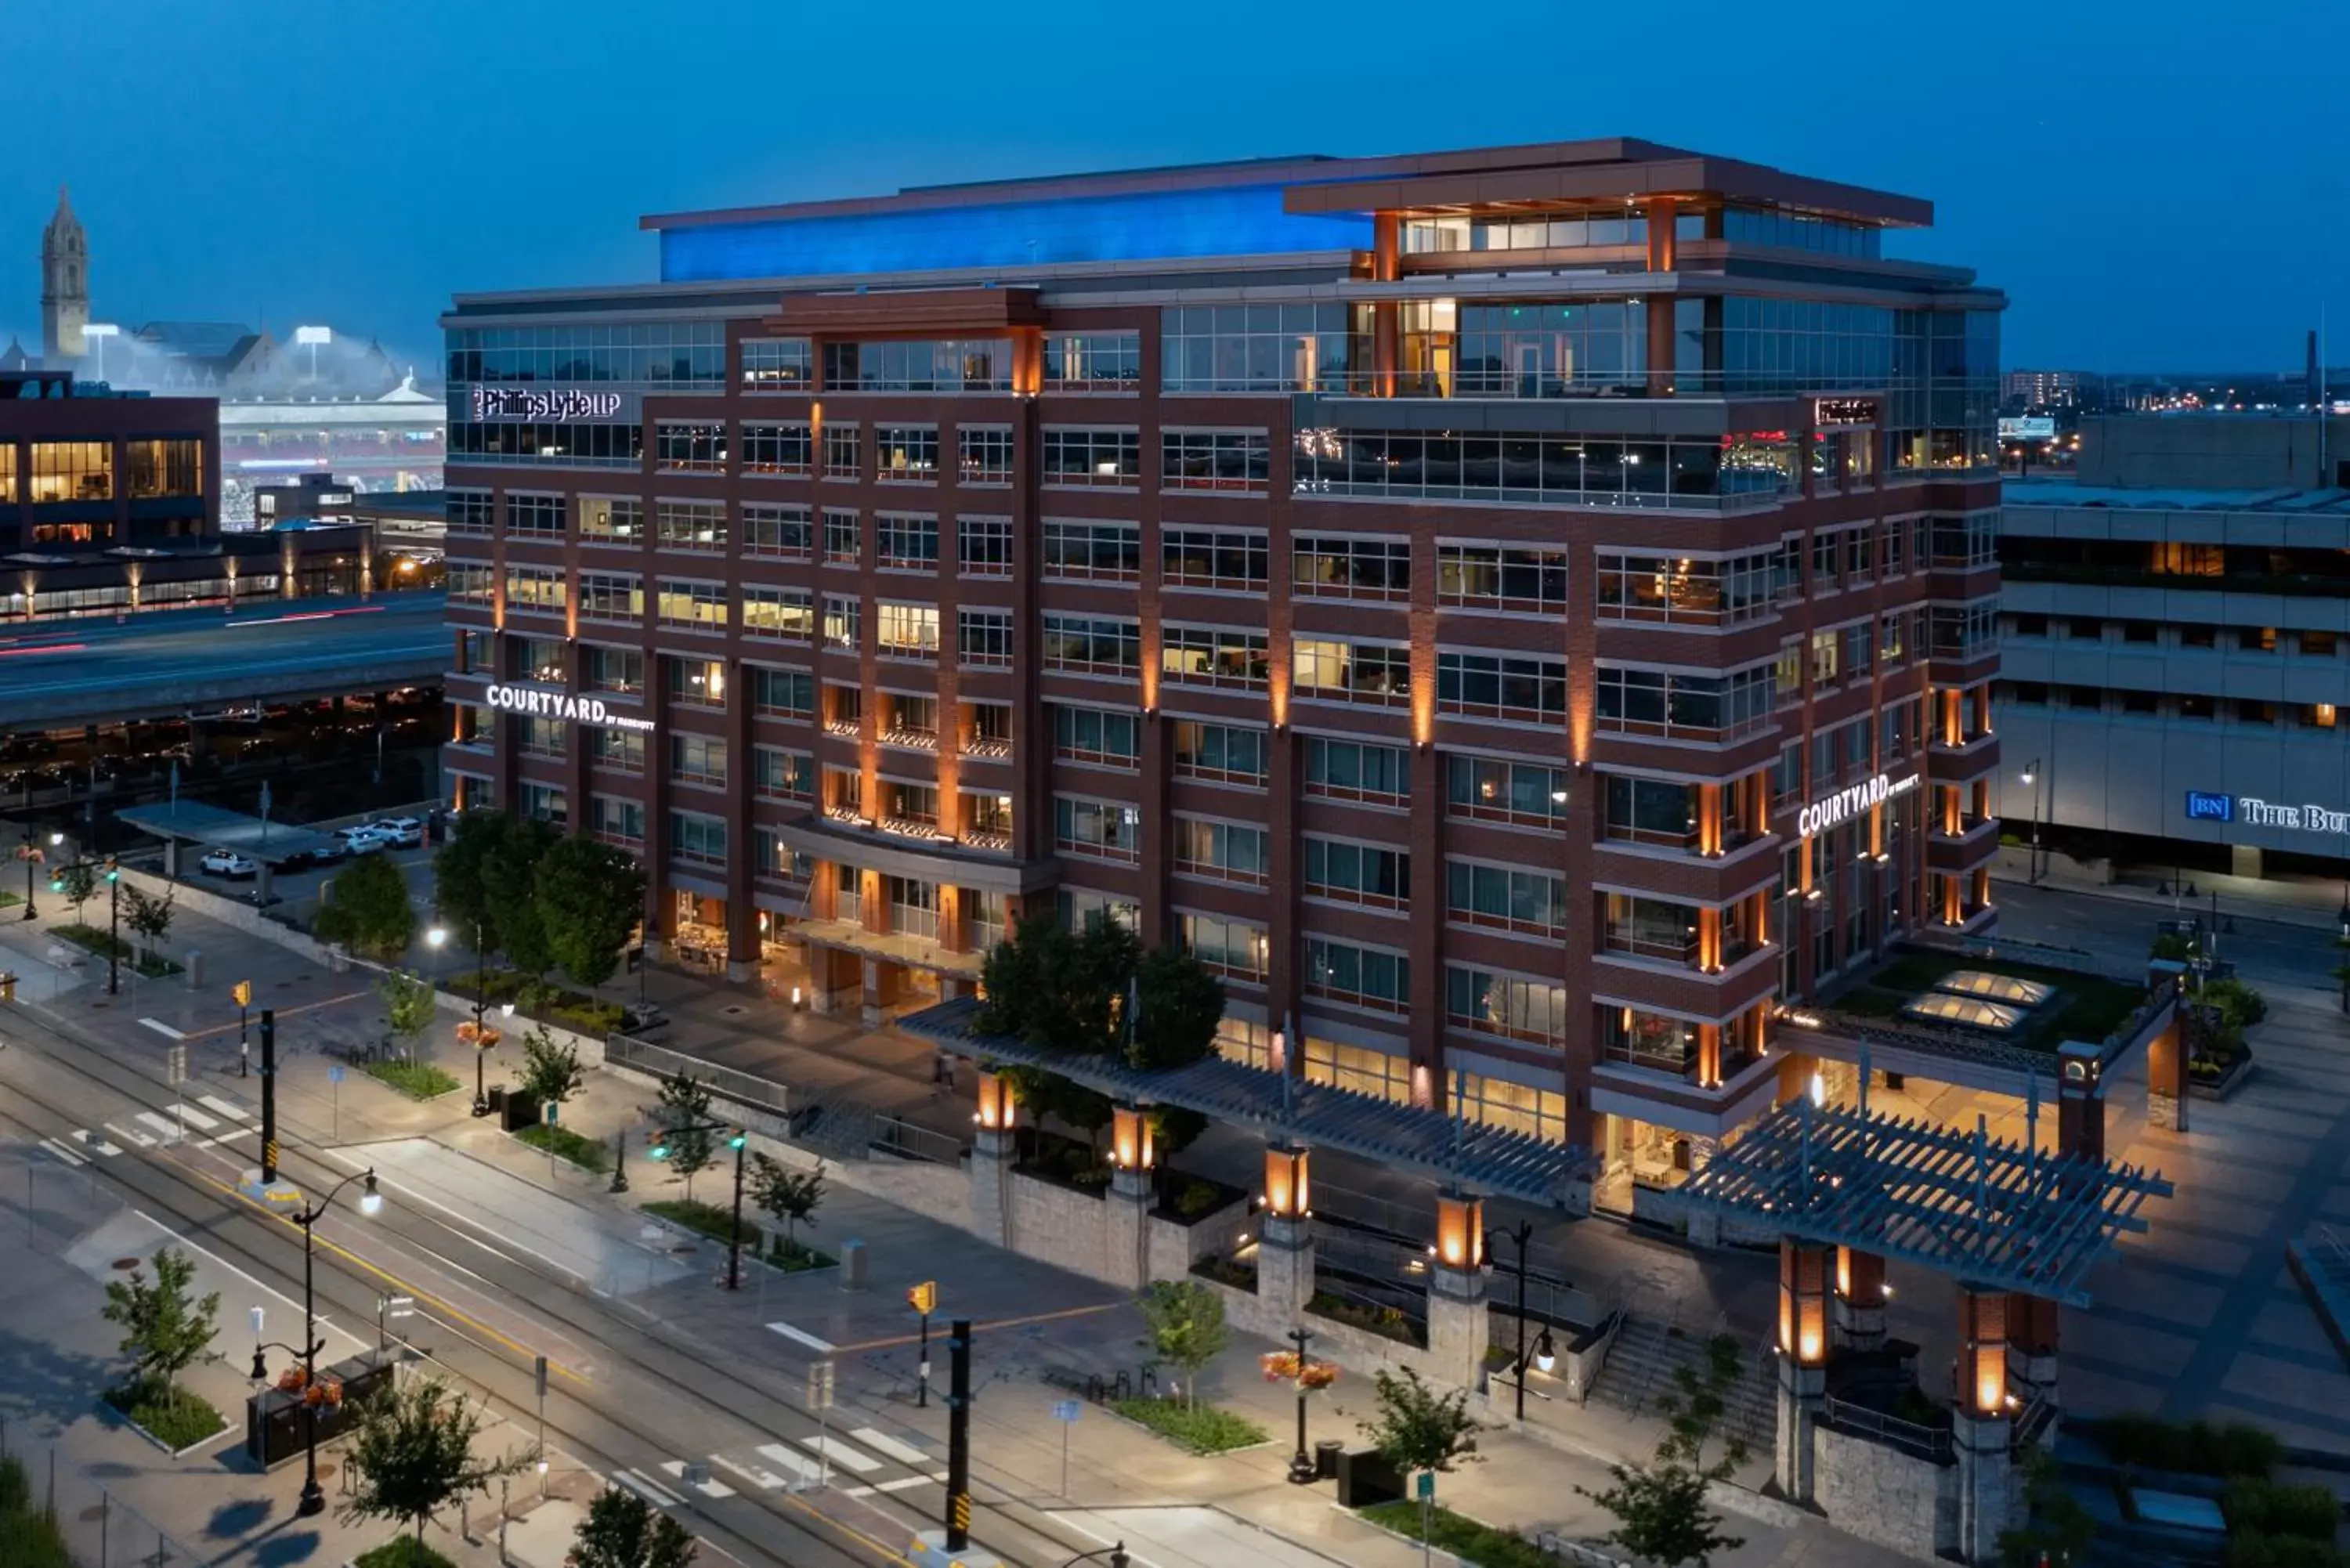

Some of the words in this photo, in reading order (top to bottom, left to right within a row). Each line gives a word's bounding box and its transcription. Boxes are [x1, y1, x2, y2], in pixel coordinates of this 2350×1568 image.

[592, 392, 621, 417] LLP
[486, 685, 606, 723] COURTYARD
[1799, 774, 1889, 837] COURTYARD
